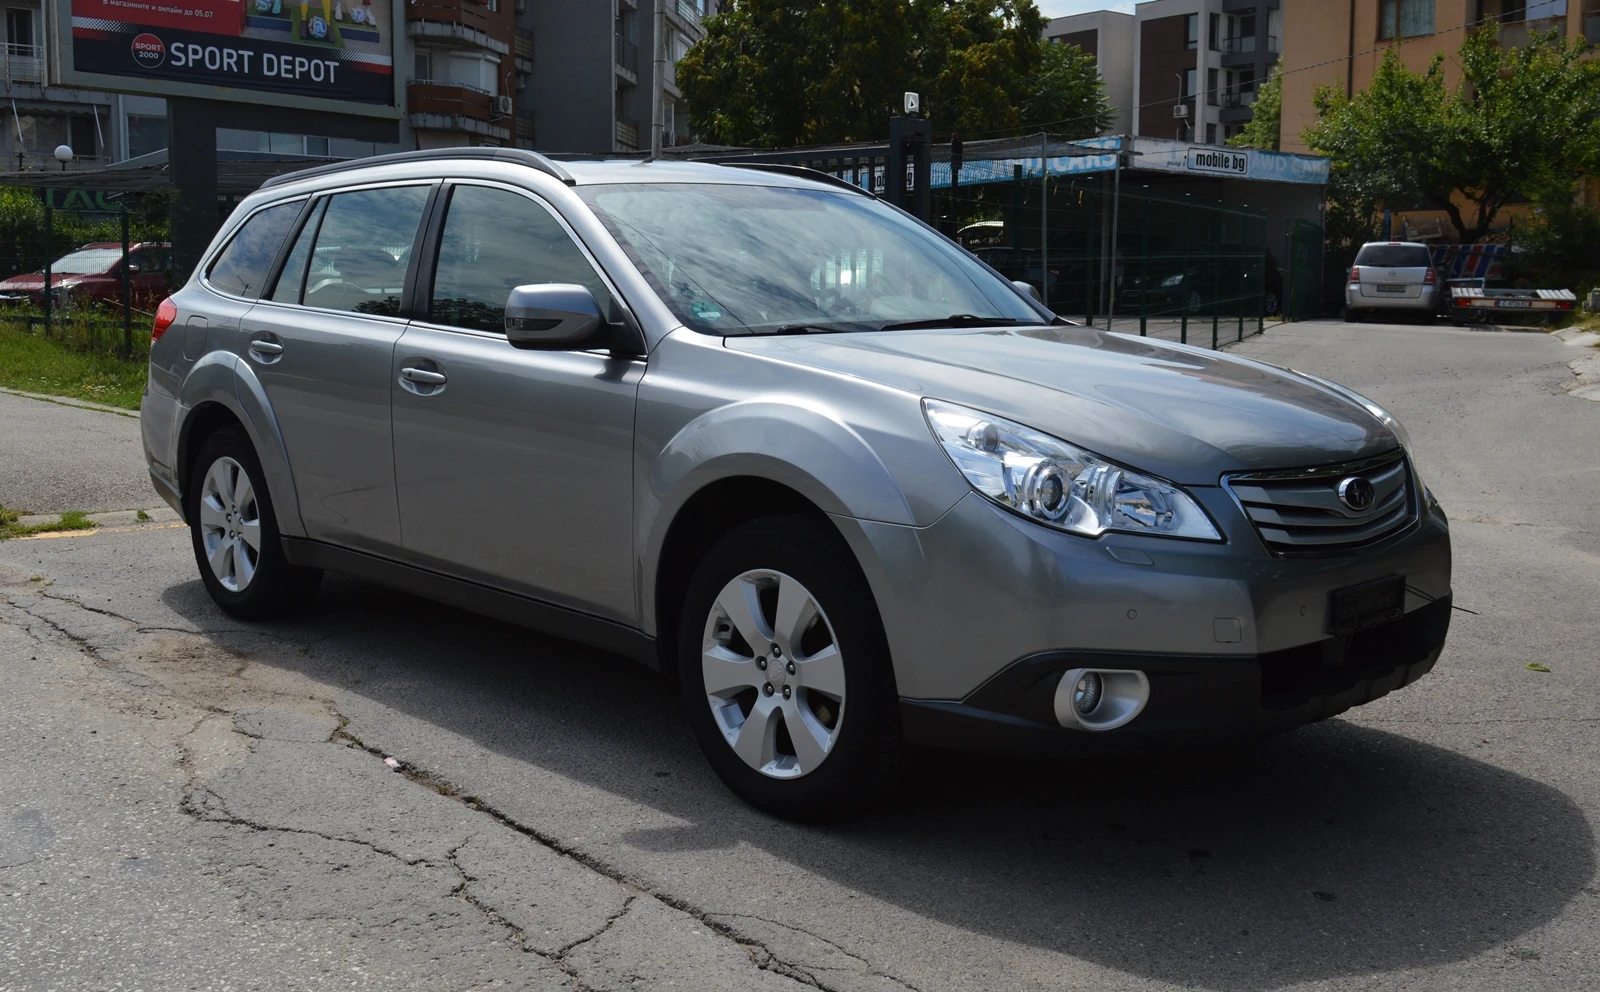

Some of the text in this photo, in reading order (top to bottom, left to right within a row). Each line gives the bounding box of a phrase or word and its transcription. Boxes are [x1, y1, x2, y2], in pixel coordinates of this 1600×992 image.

[110, 0, 150, 10] магазините
[157, 6, 182, 14] онлайн
[194, 9, 213, 18] 05.07
[135, 42, 162, 52] SPORT
[138, 51, 159, 59] 2000
[170, 42, 340, 84] SPORT DEPOT
[1195, 152, 1245, 172] mobile bg
